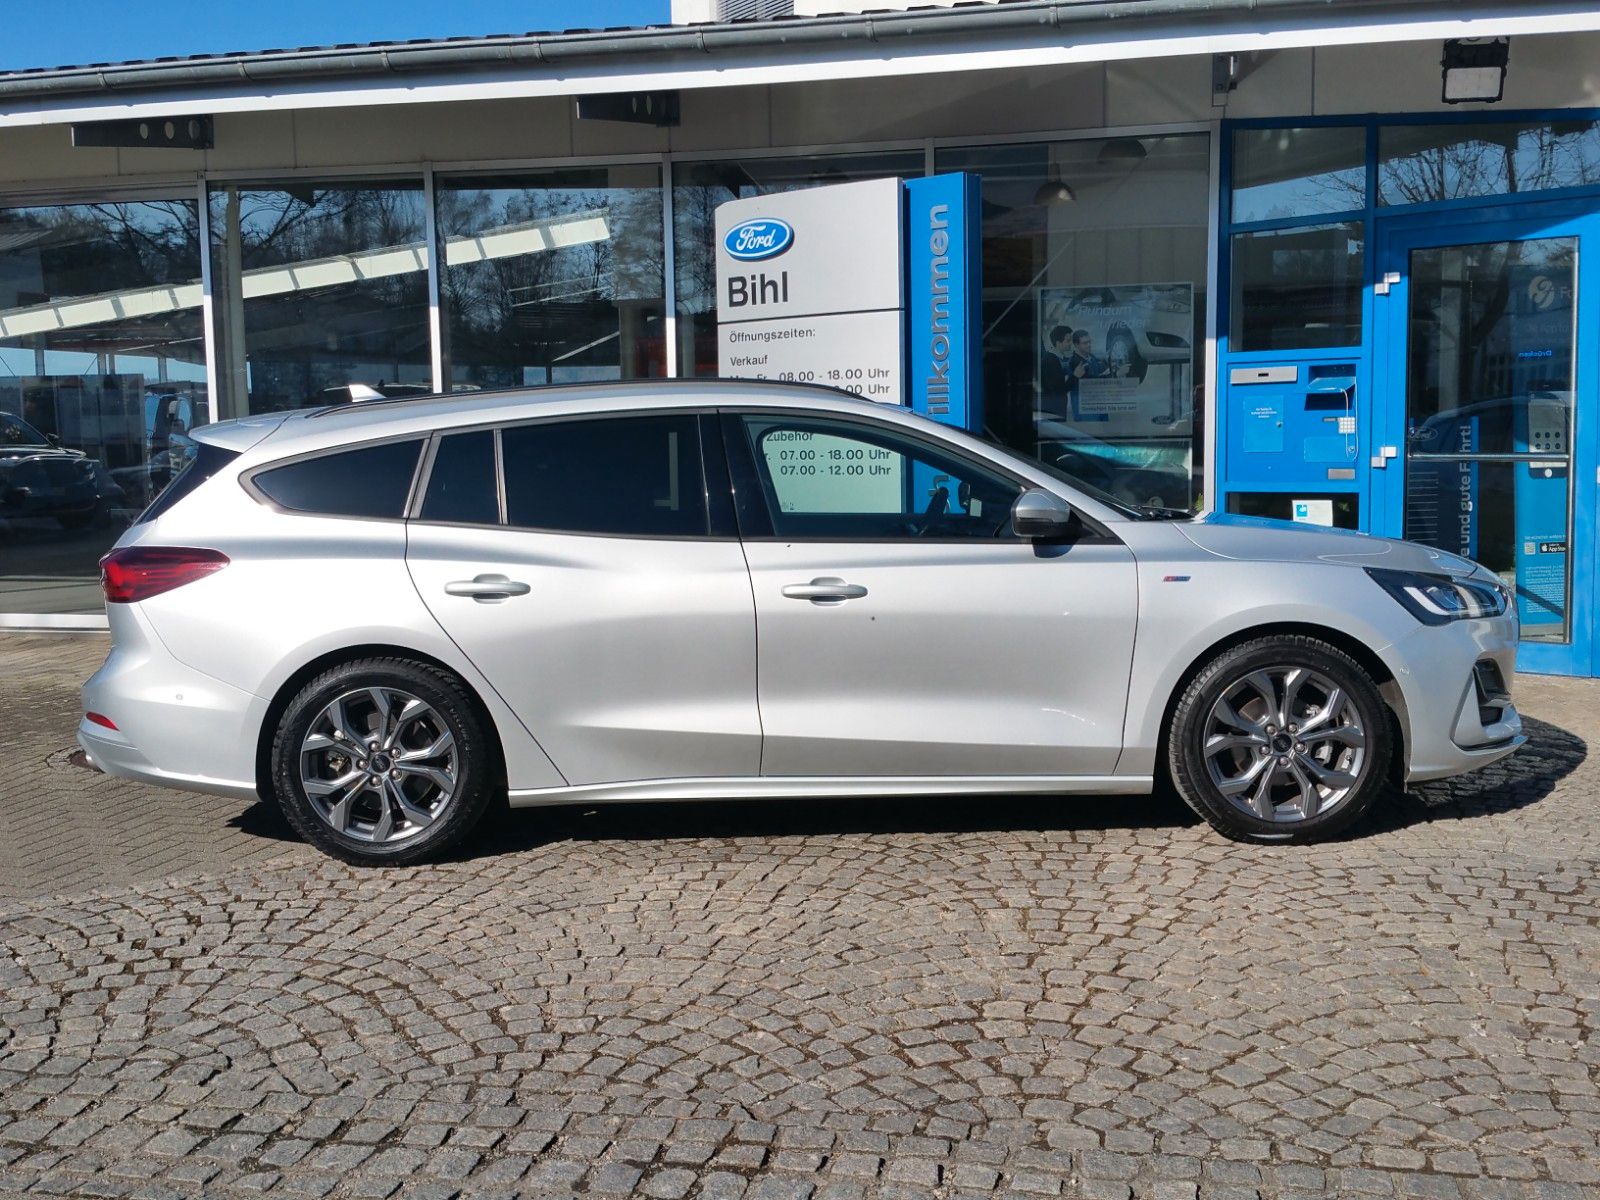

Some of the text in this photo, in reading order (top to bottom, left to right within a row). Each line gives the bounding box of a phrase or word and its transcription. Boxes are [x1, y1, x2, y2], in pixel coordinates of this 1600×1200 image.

[735, 224, 777, 251] Ford
[728, 271, 789, 308] Bihl
[927, 204, 950, 415] illkommen
[729, 328, 816, 343] Öffnungszeiten:
[730, 355, 768, 367] Verkauf
[779, 371, 814, 382] 08.00
[828, 368, 862, 380] 18.00
[868, 368, 890, 378] Uhr
[868, 384, 890, 394] Uhr
[780, 450, 816, 460] 07.00
[828, 450, 864, 460] 18.00
[868, 449, 891, 460] Uhr
[1460, 425, 1471, 473] Fhrt!
[780, 465, 816, 476] 07.00
[829, 465, 864, 476] 12.00
[869, 465, 891, 475] Uhr
[1459, 475, 1473, 512] gute
